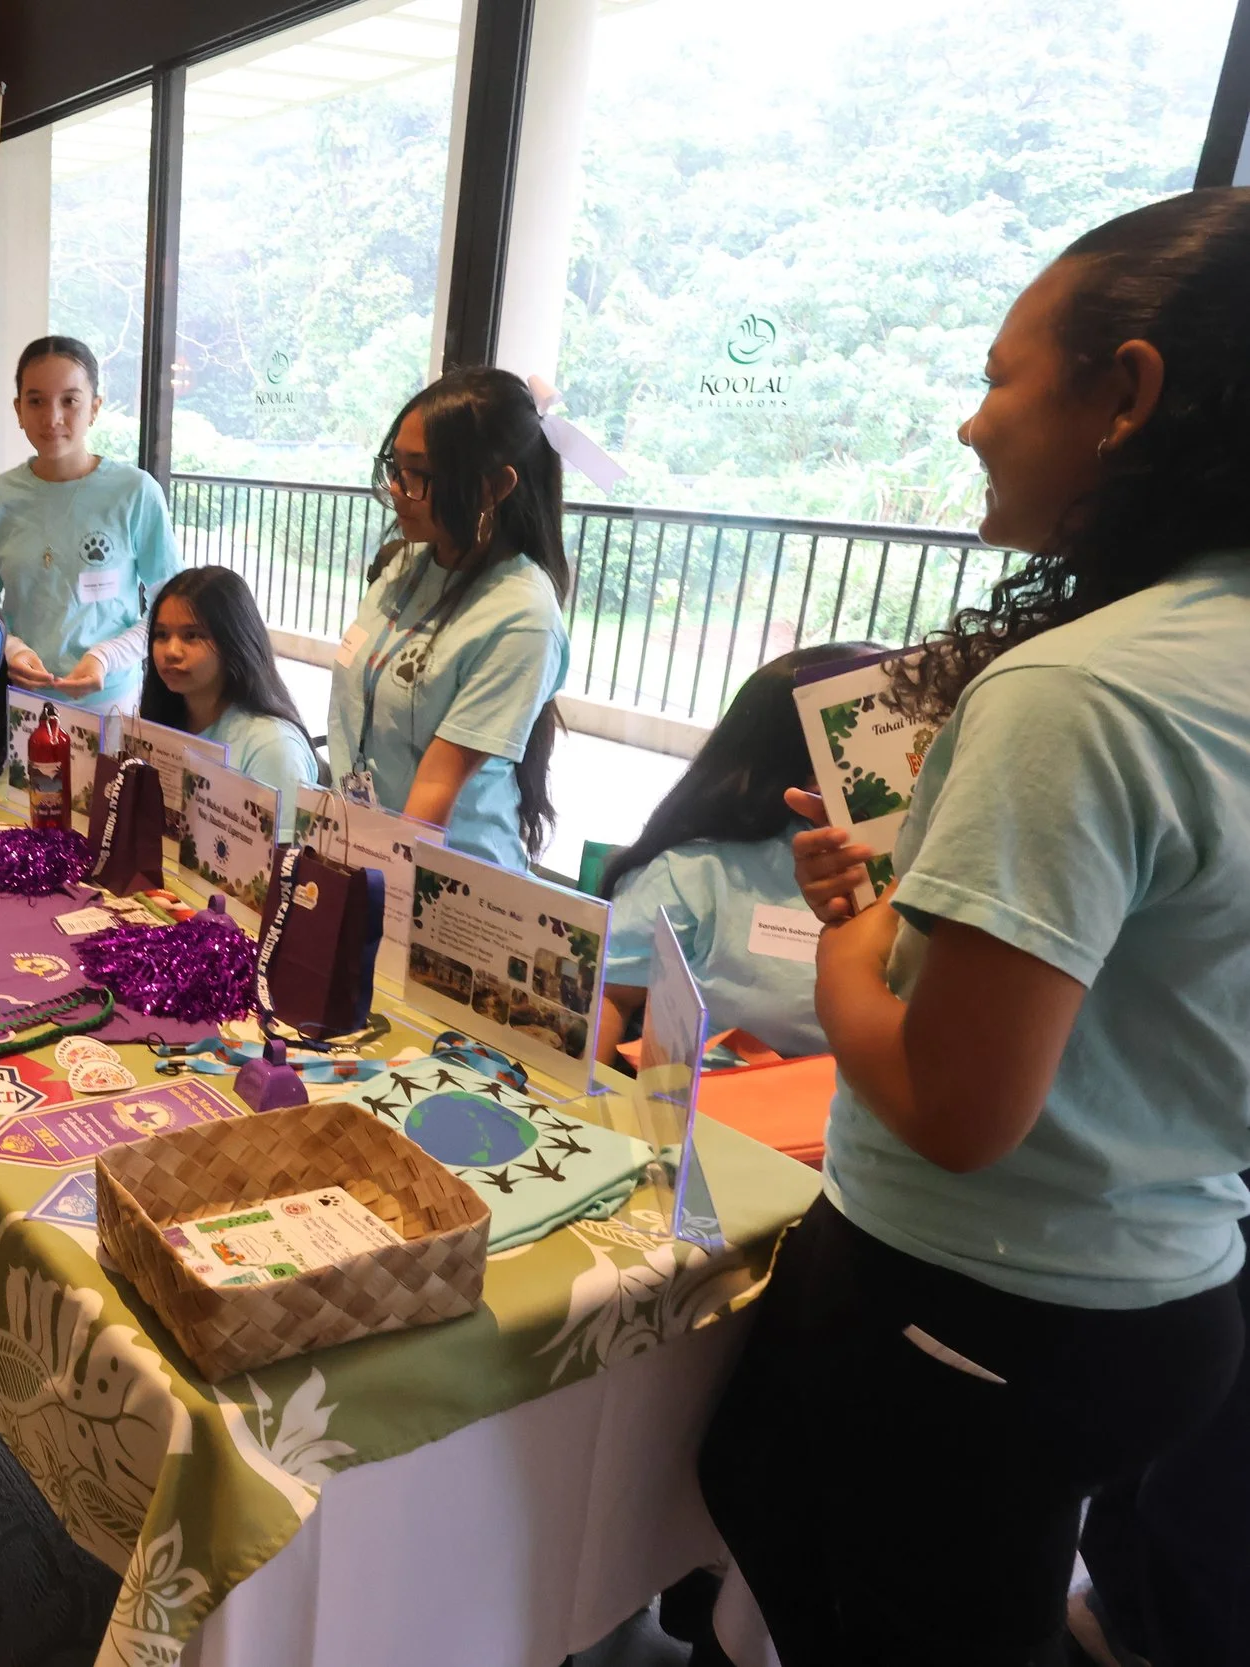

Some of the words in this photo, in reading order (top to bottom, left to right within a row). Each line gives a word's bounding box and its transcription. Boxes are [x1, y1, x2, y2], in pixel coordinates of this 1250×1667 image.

[871, 718, 904, 735] Takai
[101, 810, 117, 849] MIDDLE
[280, 848, 301, 878] EWA
[273, 880, 290, 926] MAKAI
[257, 924, 283, 974] MIDDLE
